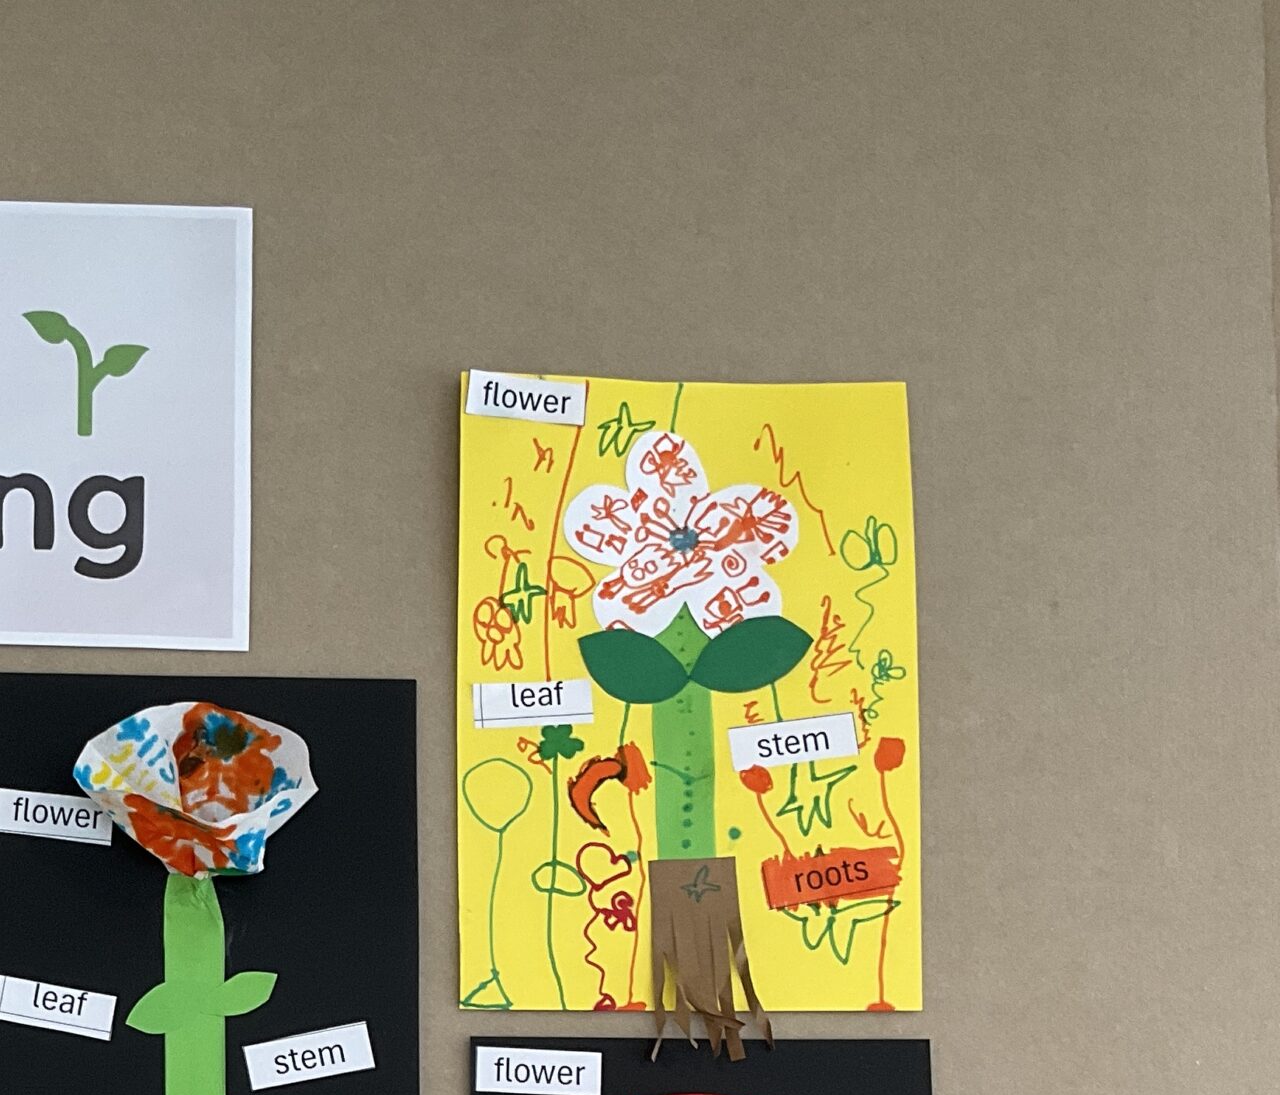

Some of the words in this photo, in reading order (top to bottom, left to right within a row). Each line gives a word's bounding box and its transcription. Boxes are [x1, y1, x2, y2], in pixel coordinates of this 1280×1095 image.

[483, 381, 571, 414] flower
[511, 682, 563, 707] leaf
[758, 729, 829, 758] stem
[13, 798, 103, 828] flower
[794, 858, 869, 891] roots
[33, 983, 88, 1016] leaf
[274, 1042, 345, 1074] stem
[494, 1057, 585, 1085] flower
